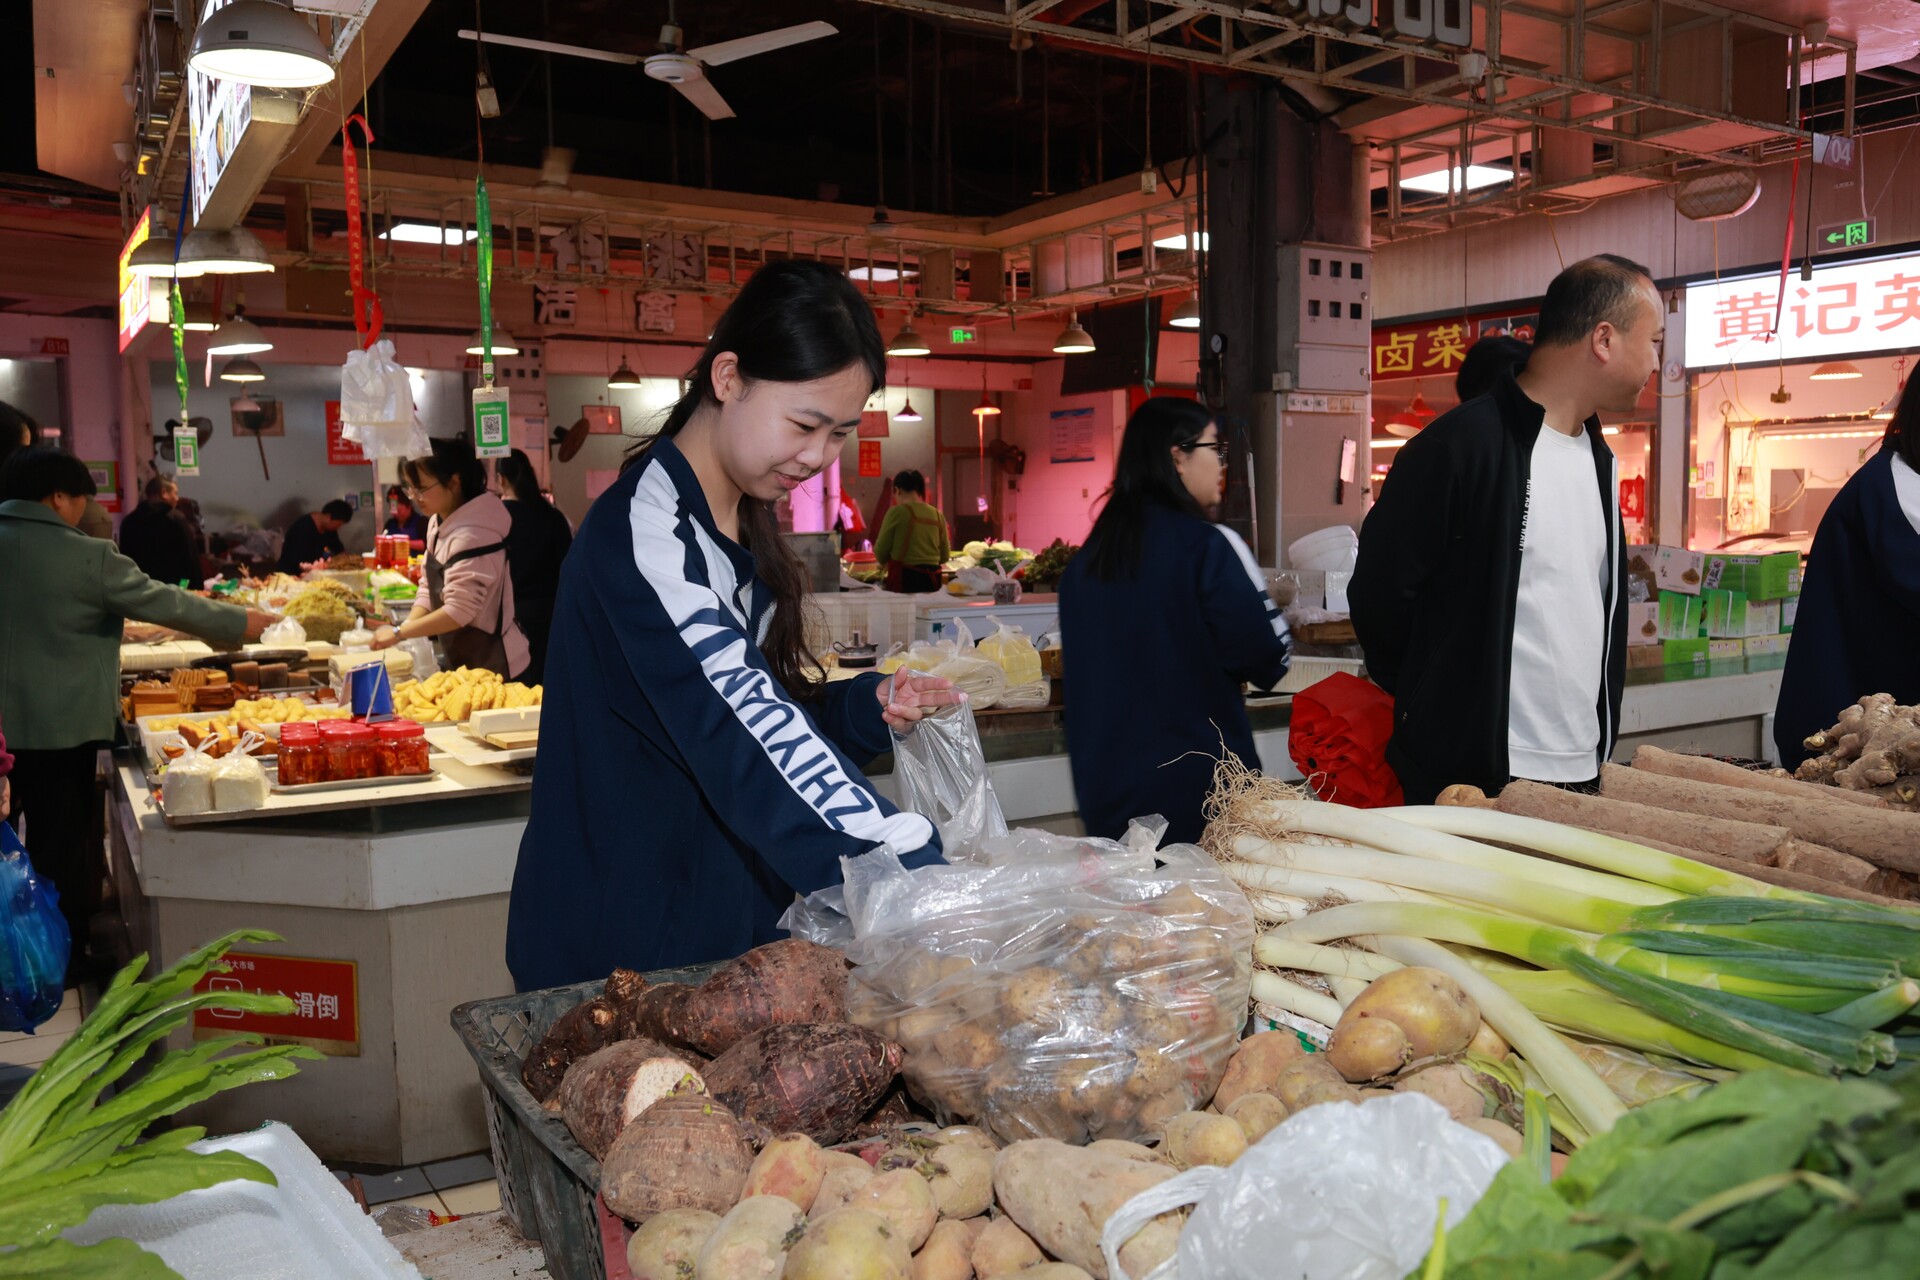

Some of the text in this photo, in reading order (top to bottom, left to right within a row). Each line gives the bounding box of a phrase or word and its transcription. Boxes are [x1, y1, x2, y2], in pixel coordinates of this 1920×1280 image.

[1831, 139, 1852, 166] 04
[1376, 324, 1467, 374] 卤菜
[709, 666, 875, 831] ZHIYUAN
